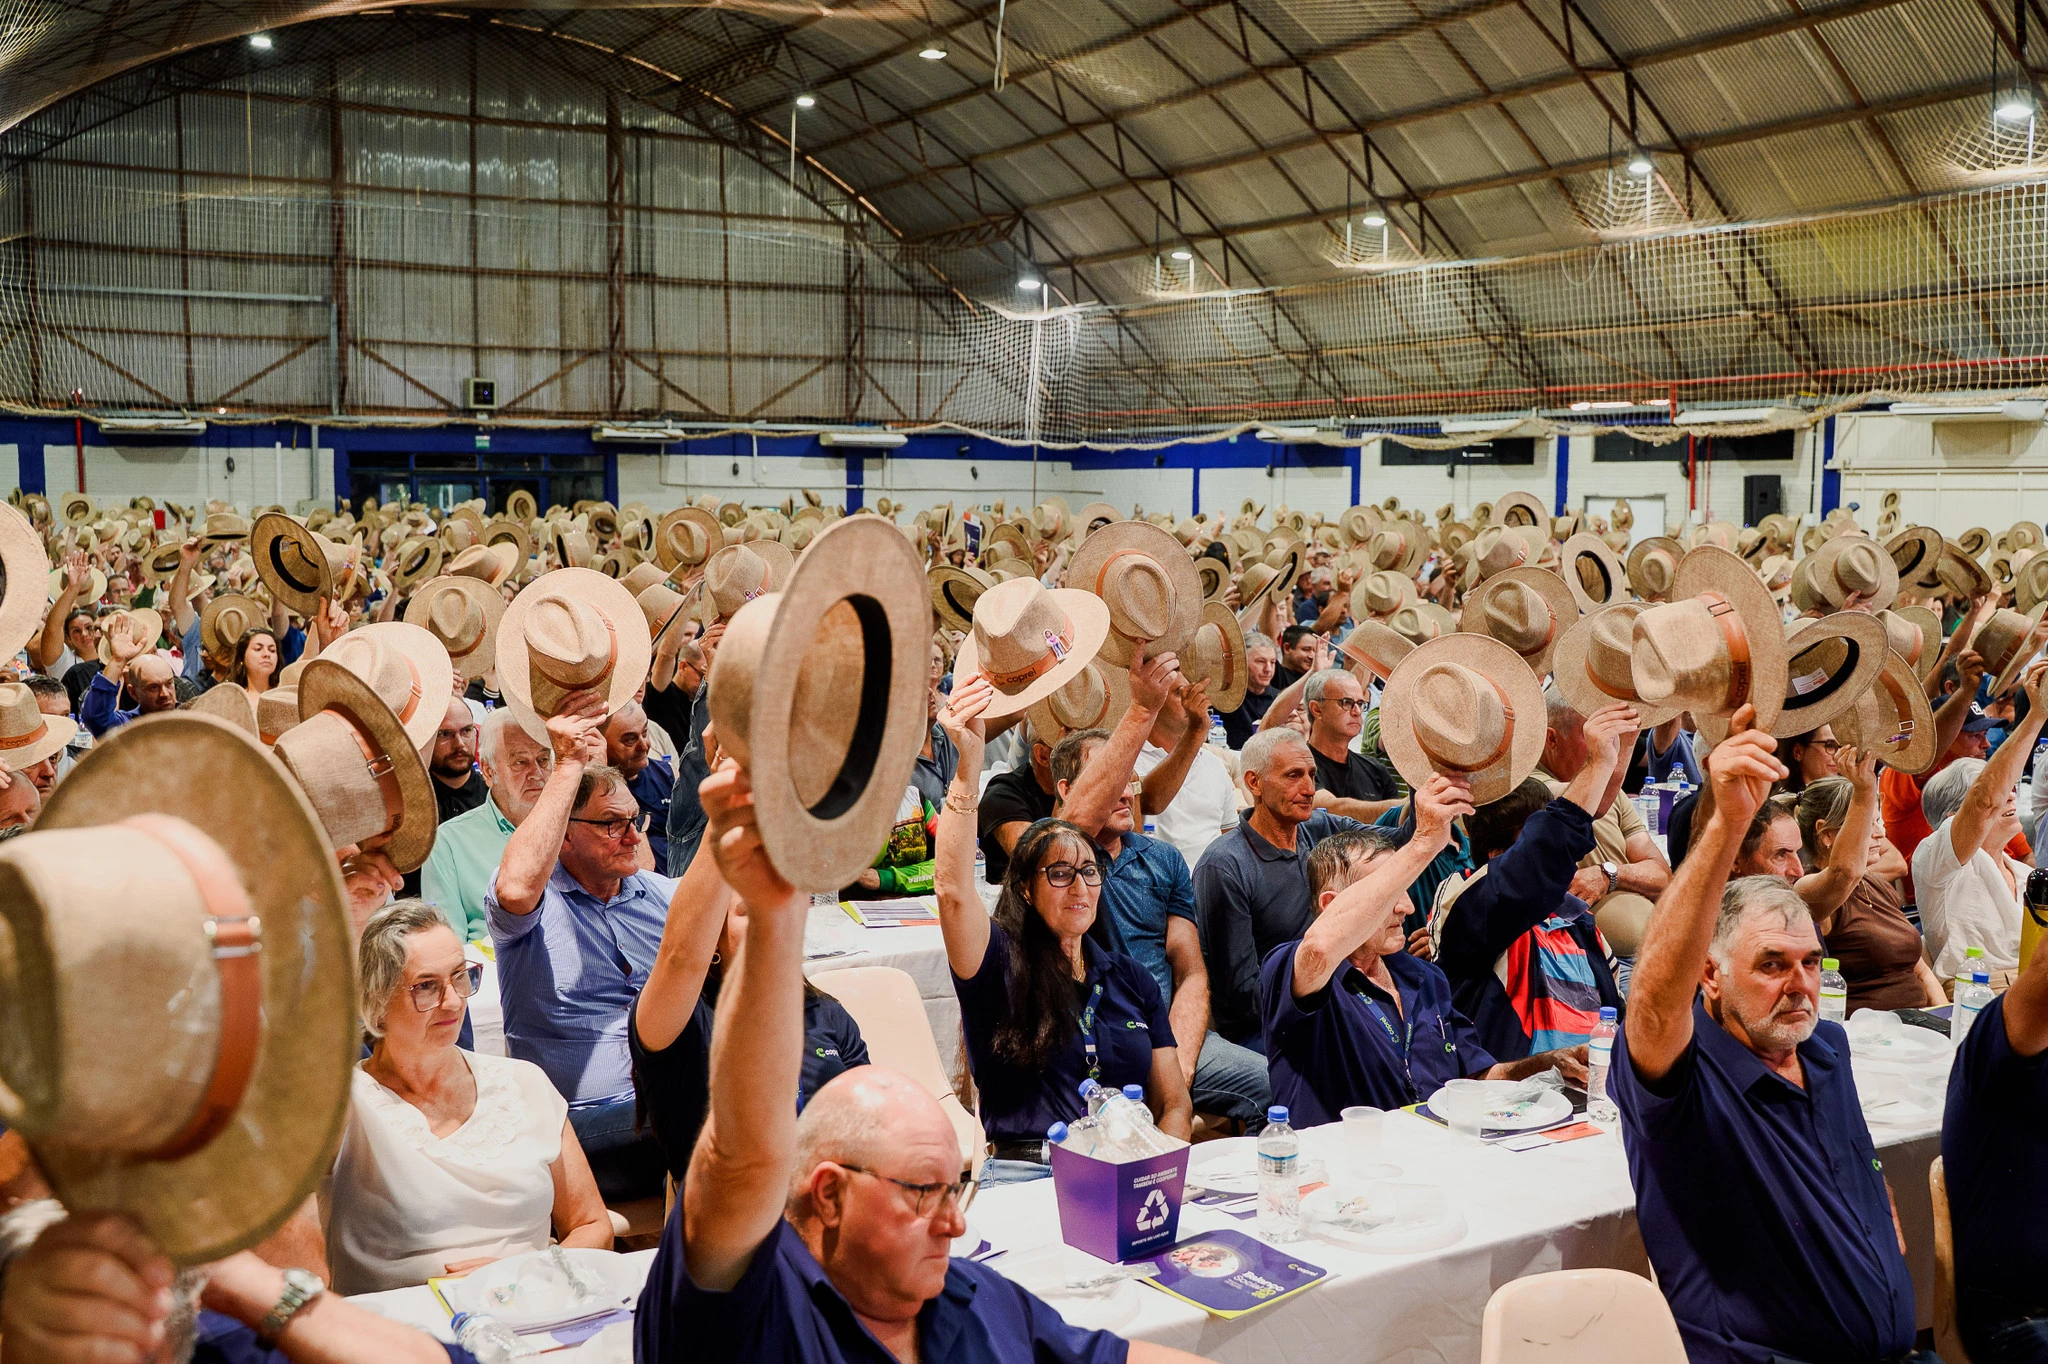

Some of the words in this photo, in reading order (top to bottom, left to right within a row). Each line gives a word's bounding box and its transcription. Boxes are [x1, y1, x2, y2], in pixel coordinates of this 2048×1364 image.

[1006, 668, 1037, 684] coprel
[1735, 661, 1749, 698] coprel
[6, 736, 31, 747] coprel
[1476, 750, 1503, 770] coprel
[1380, 1016, 1395, 1035] coprel
[1233, 1275, 1265, 1290] Social
